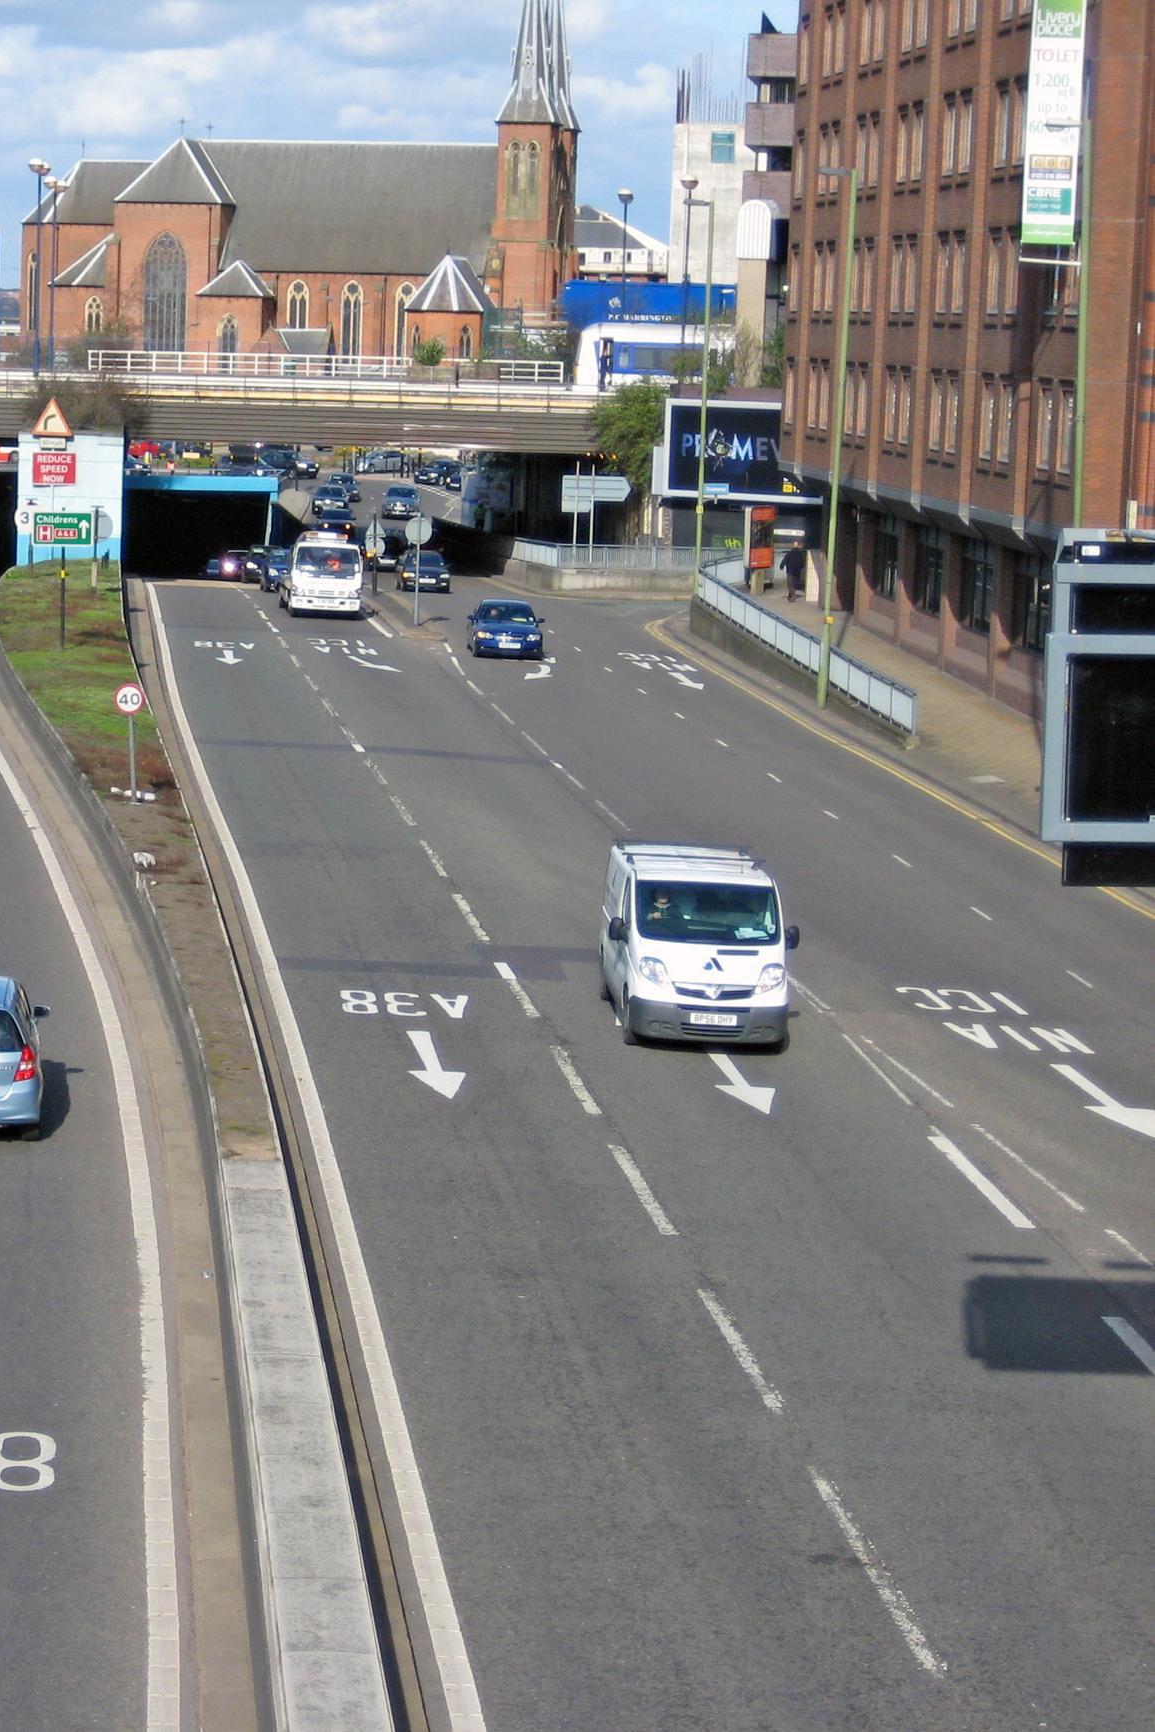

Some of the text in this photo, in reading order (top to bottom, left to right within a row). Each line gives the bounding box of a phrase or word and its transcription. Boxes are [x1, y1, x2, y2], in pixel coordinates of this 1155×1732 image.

[1037, 8, 1081, 27] Livery
[1036, 22, 1074, 37] place
[1034, 49, 1080, 62] TO LET
[1034, 74, 1070, 89] 1,200
[1038, 102, 1068, 114] up to
[40, 465, 68, 473] SPEED
[43, 475, 64, 483] NOW
[20, 512, 29, 524] 3
[37, 515, 78, 524] Childrens
[39, 527, 51, 540] H
[119, 693, 140, 705] 40
[340, 990, 468, 1019] A38
[895, 986, 1029, 1015] ICC
[942, 1022, 1095, 1054] NIA
